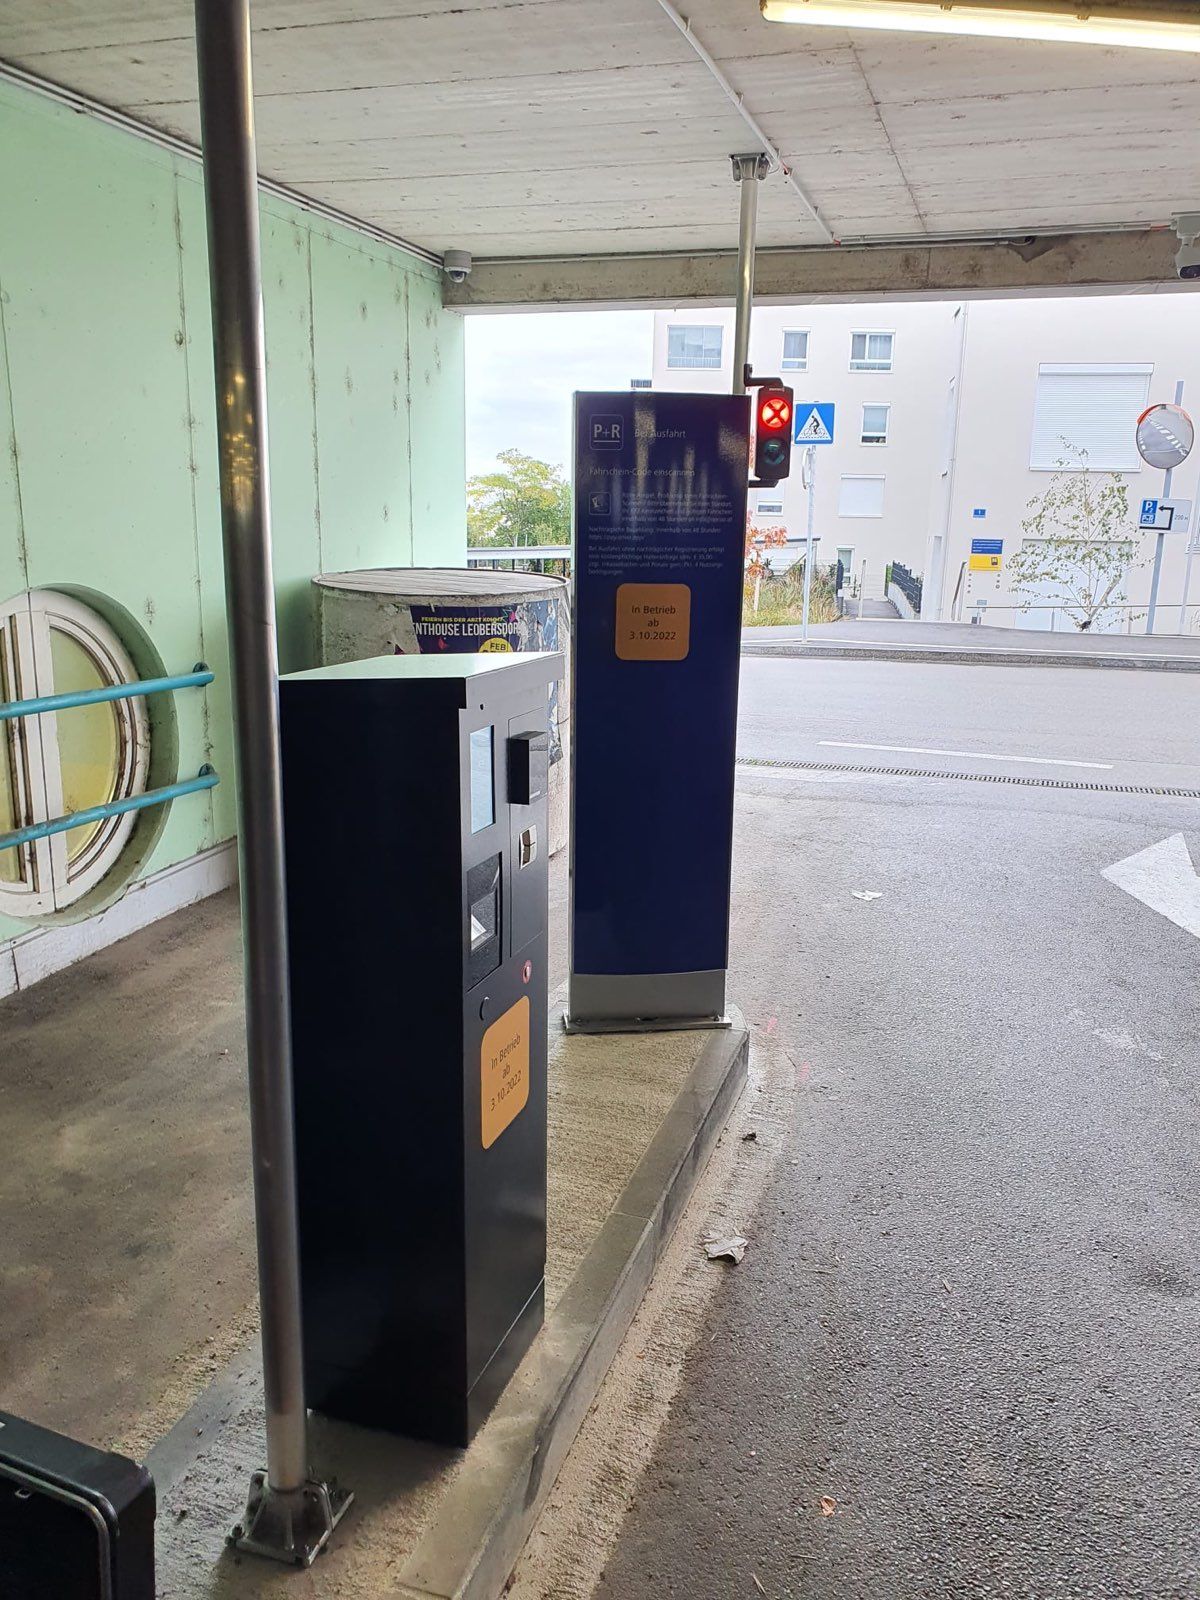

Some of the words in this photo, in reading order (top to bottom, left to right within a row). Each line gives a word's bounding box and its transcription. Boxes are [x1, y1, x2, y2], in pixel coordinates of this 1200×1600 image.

[594, 423, 620, 439] P+R
[631, 605, 641, 614] In
[643, 605, 676, 614] Betrieb
[647, 618, 660, 627] ab
[629, 631, 676, 640] 3.10.2022
[490, 642, 506, 651] FEB
[491, 1056, 498, 1071] In
[499, 1033, 521, 1064] Betrieb
[502, 1062, 511, 1079] ab
[490, 1069, 522, 1112] 3.10.2022
